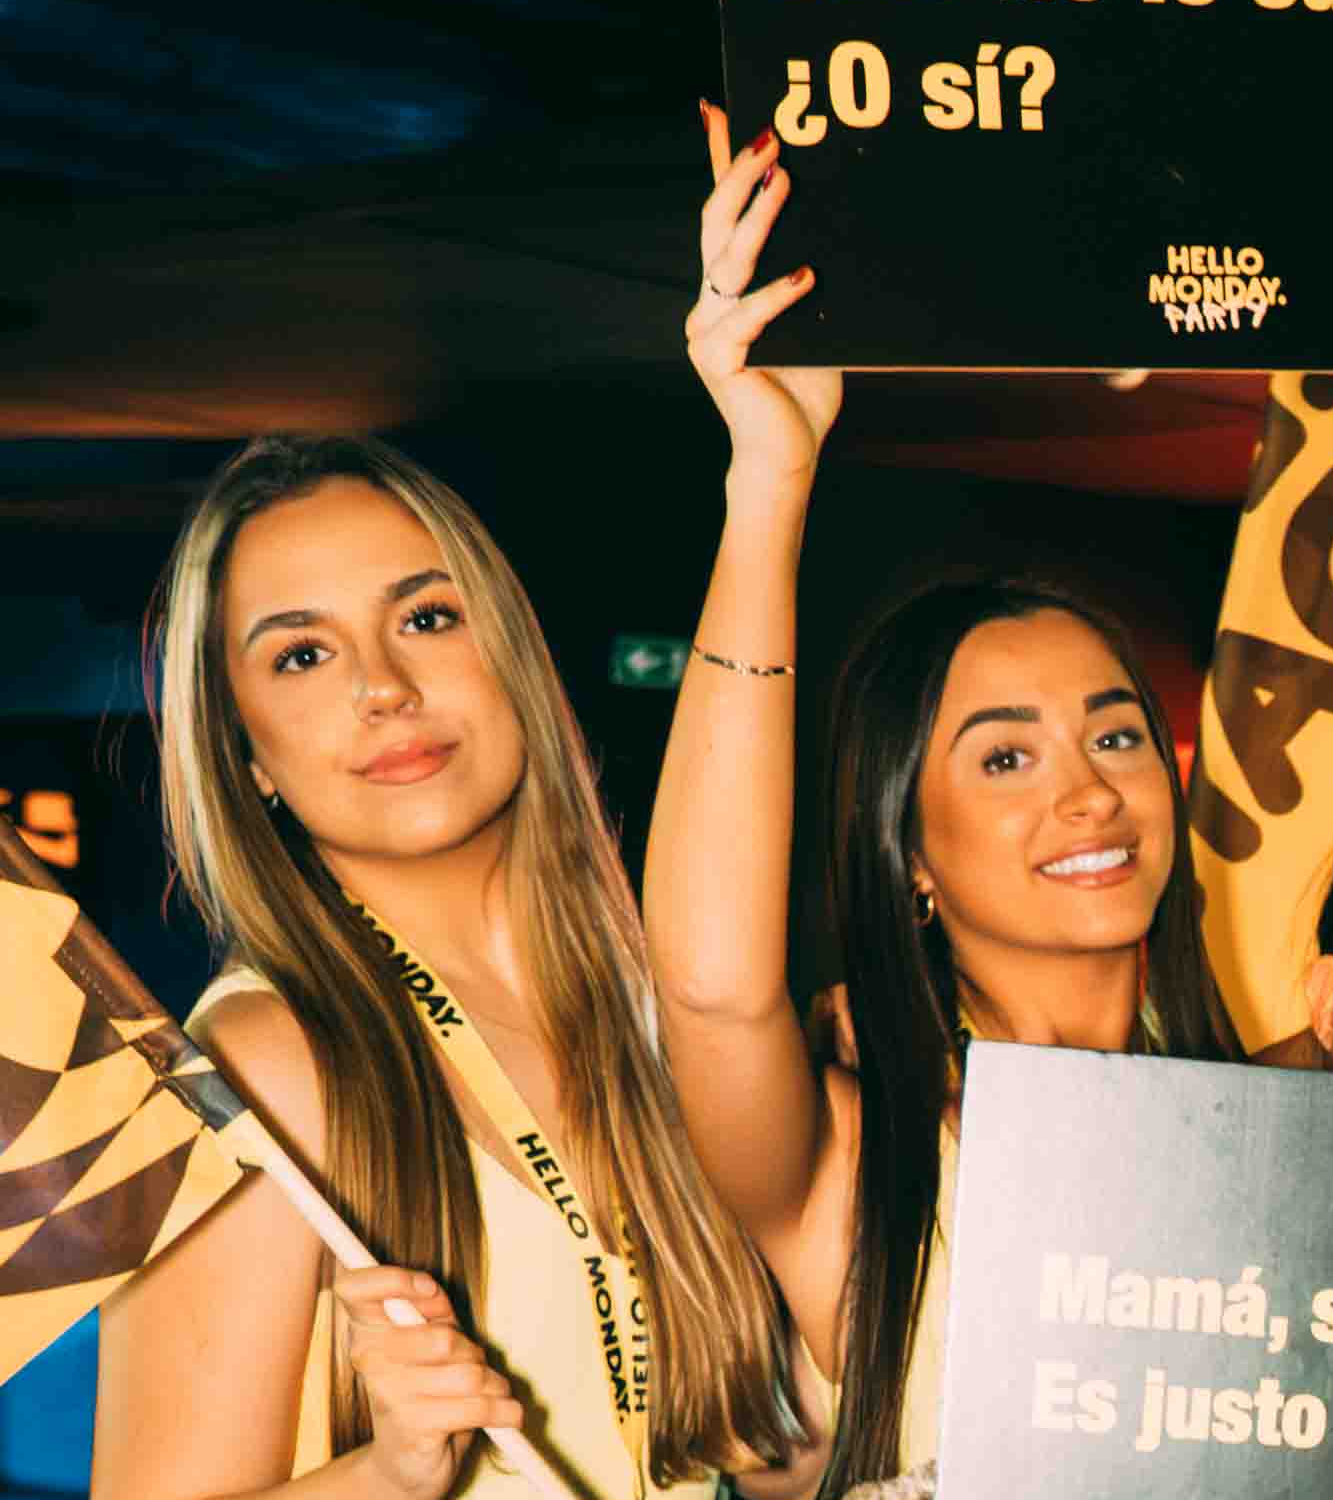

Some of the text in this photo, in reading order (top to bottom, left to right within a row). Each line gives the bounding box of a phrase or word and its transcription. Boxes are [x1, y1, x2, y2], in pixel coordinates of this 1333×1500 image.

[771, 39, 1057, 148] ¿O sí?
[1148, 274, 1288, 308] MONDAY.
[1167, 245, 1264, 279] HELLO
[1164, 299, 1269, 334] PARTY
[517, 1132, 591, 1240] HELLO
[584, 1257, 631, 1423] MONDAY.
[1040, 1251, 1290, 1355] Mamá,
[1032, 1362, 1117, 1434] Es
[1136, 1368, 1327, 1453] justo
